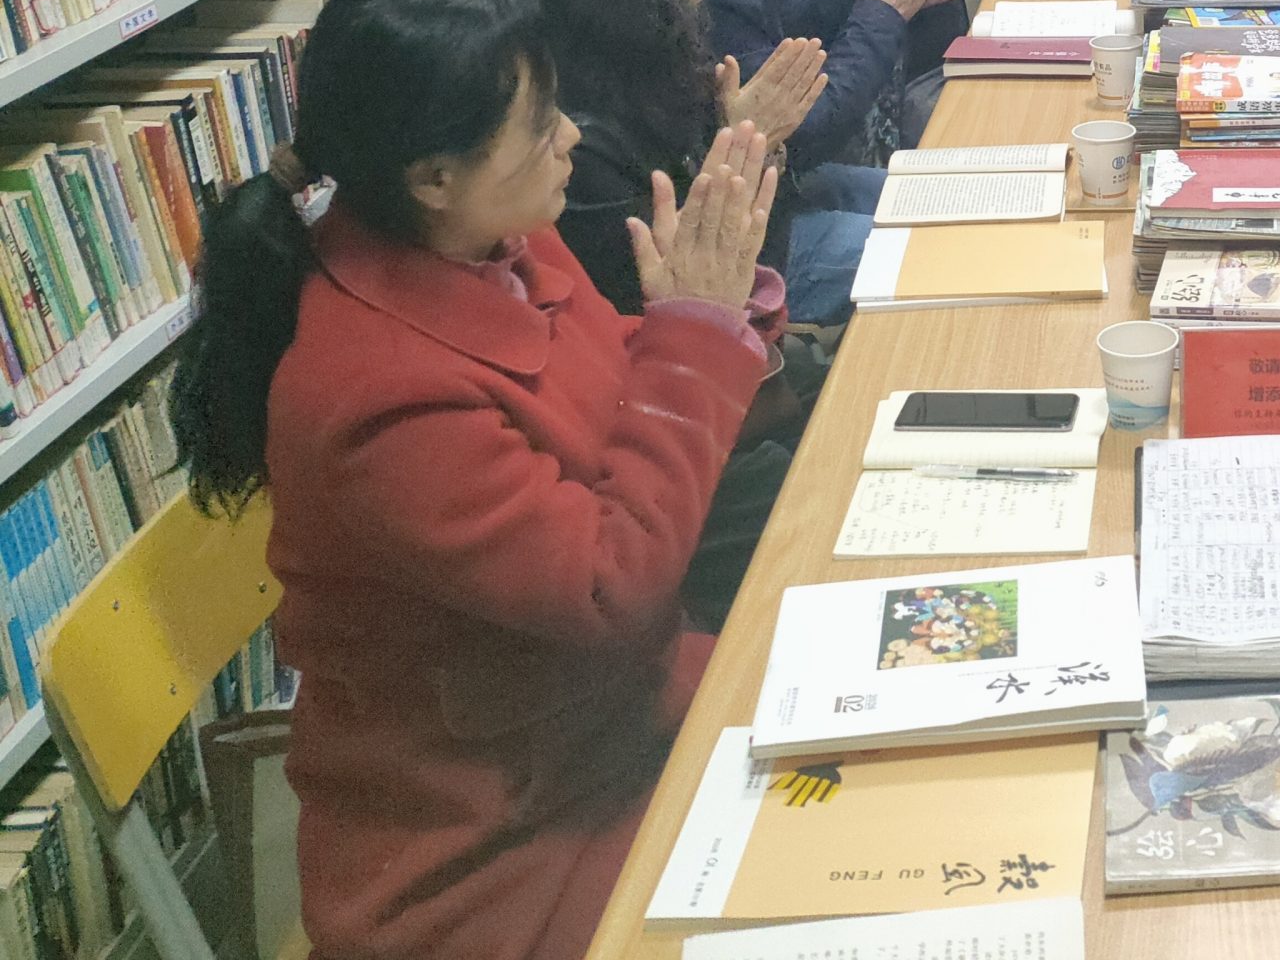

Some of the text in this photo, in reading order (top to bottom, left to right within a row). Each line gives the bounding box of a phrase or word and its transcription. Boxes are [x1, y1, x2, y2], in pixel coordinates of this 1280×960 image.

[842, 694, 864, 714] 02
[829, 868, 925, 881] GU FENG
